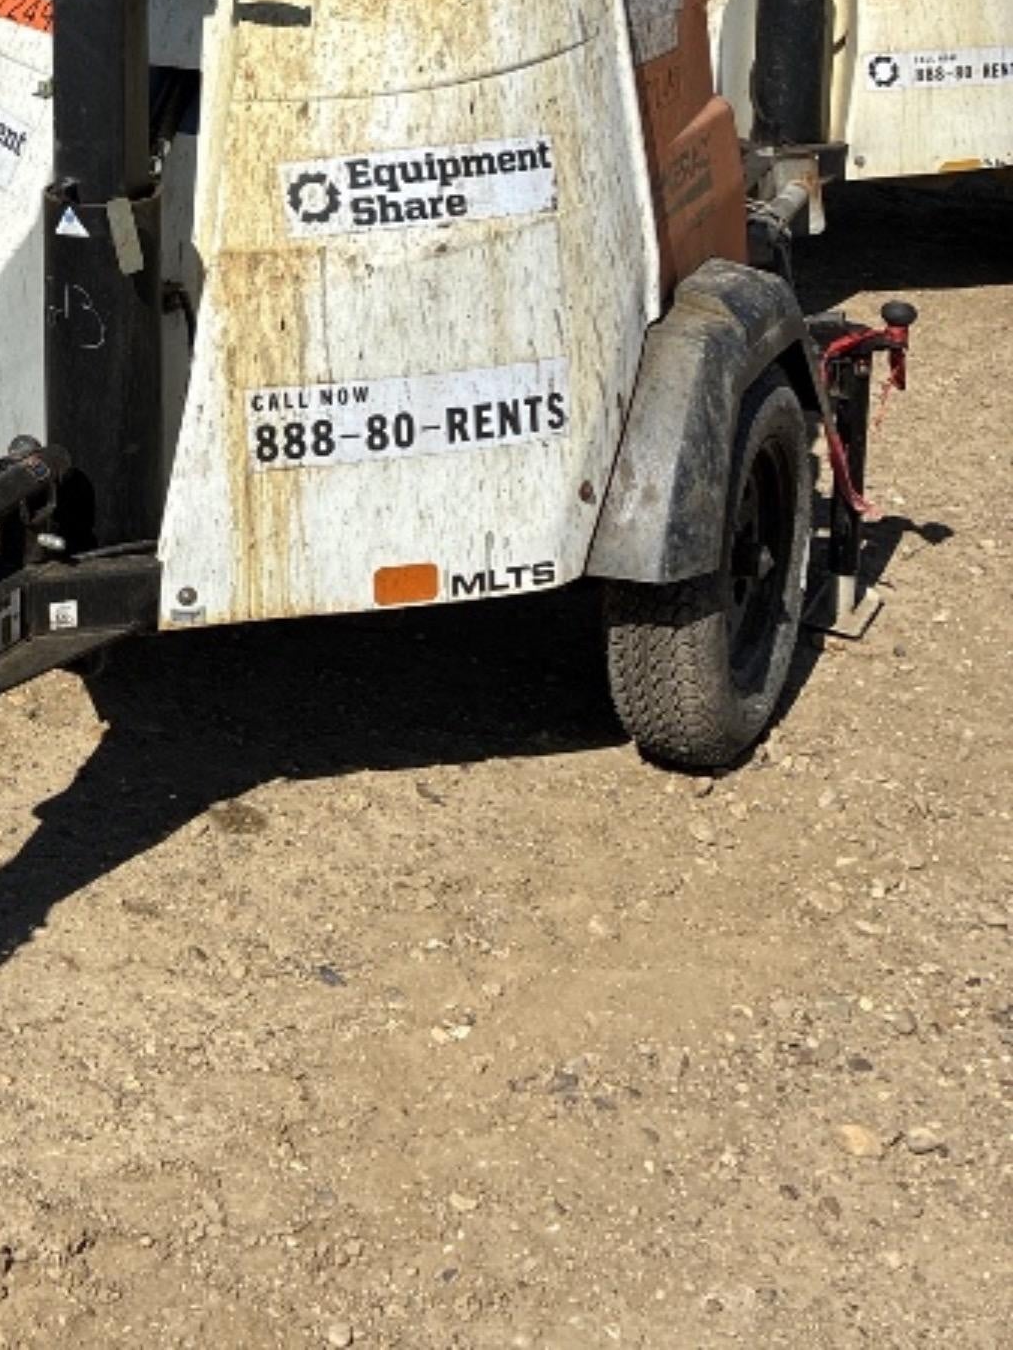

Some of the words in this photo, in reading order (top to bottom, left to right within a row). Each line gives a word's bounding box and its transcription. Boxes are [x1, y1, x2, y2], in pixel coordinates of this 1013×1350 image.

[344, 141, 552, 192] Equipment
[349, 193, 468, 226] Share
[250, 394, 309, 412] CALL
[319, 385, 369, 406] NOW
[254, 392, 566, 463] 888-80-RENTS
[451, 560, 556, 598] MLTS
